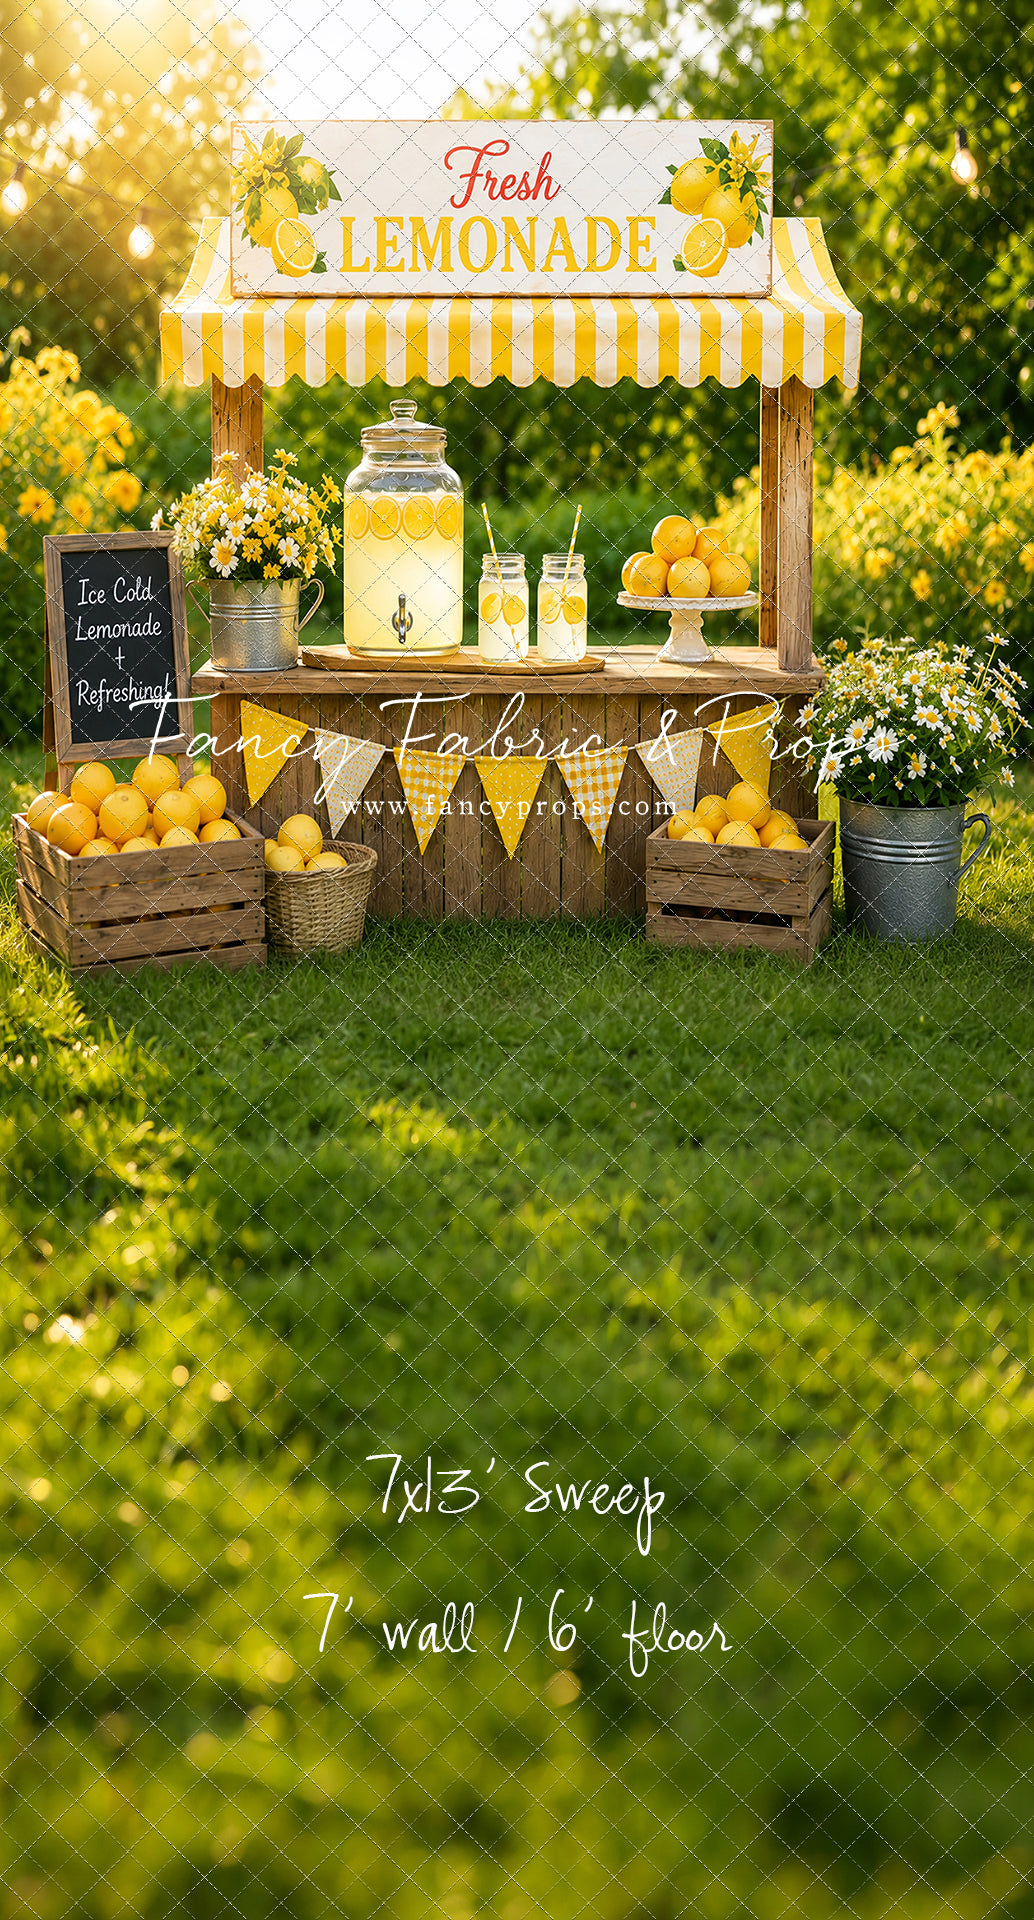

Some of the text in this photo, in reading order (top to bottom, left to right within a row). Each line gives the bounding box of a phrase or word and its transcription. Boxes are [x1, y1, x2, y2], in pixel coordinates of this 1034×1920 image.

[444, 139, 561, 209] Fresh
[339, 216, 657, 273] LEMONADE
[77, 576, 153, 605] Ice Cold
[75, 612, 162, 641] Lemonade
[75, 672, 170, 712] Refreshing!
